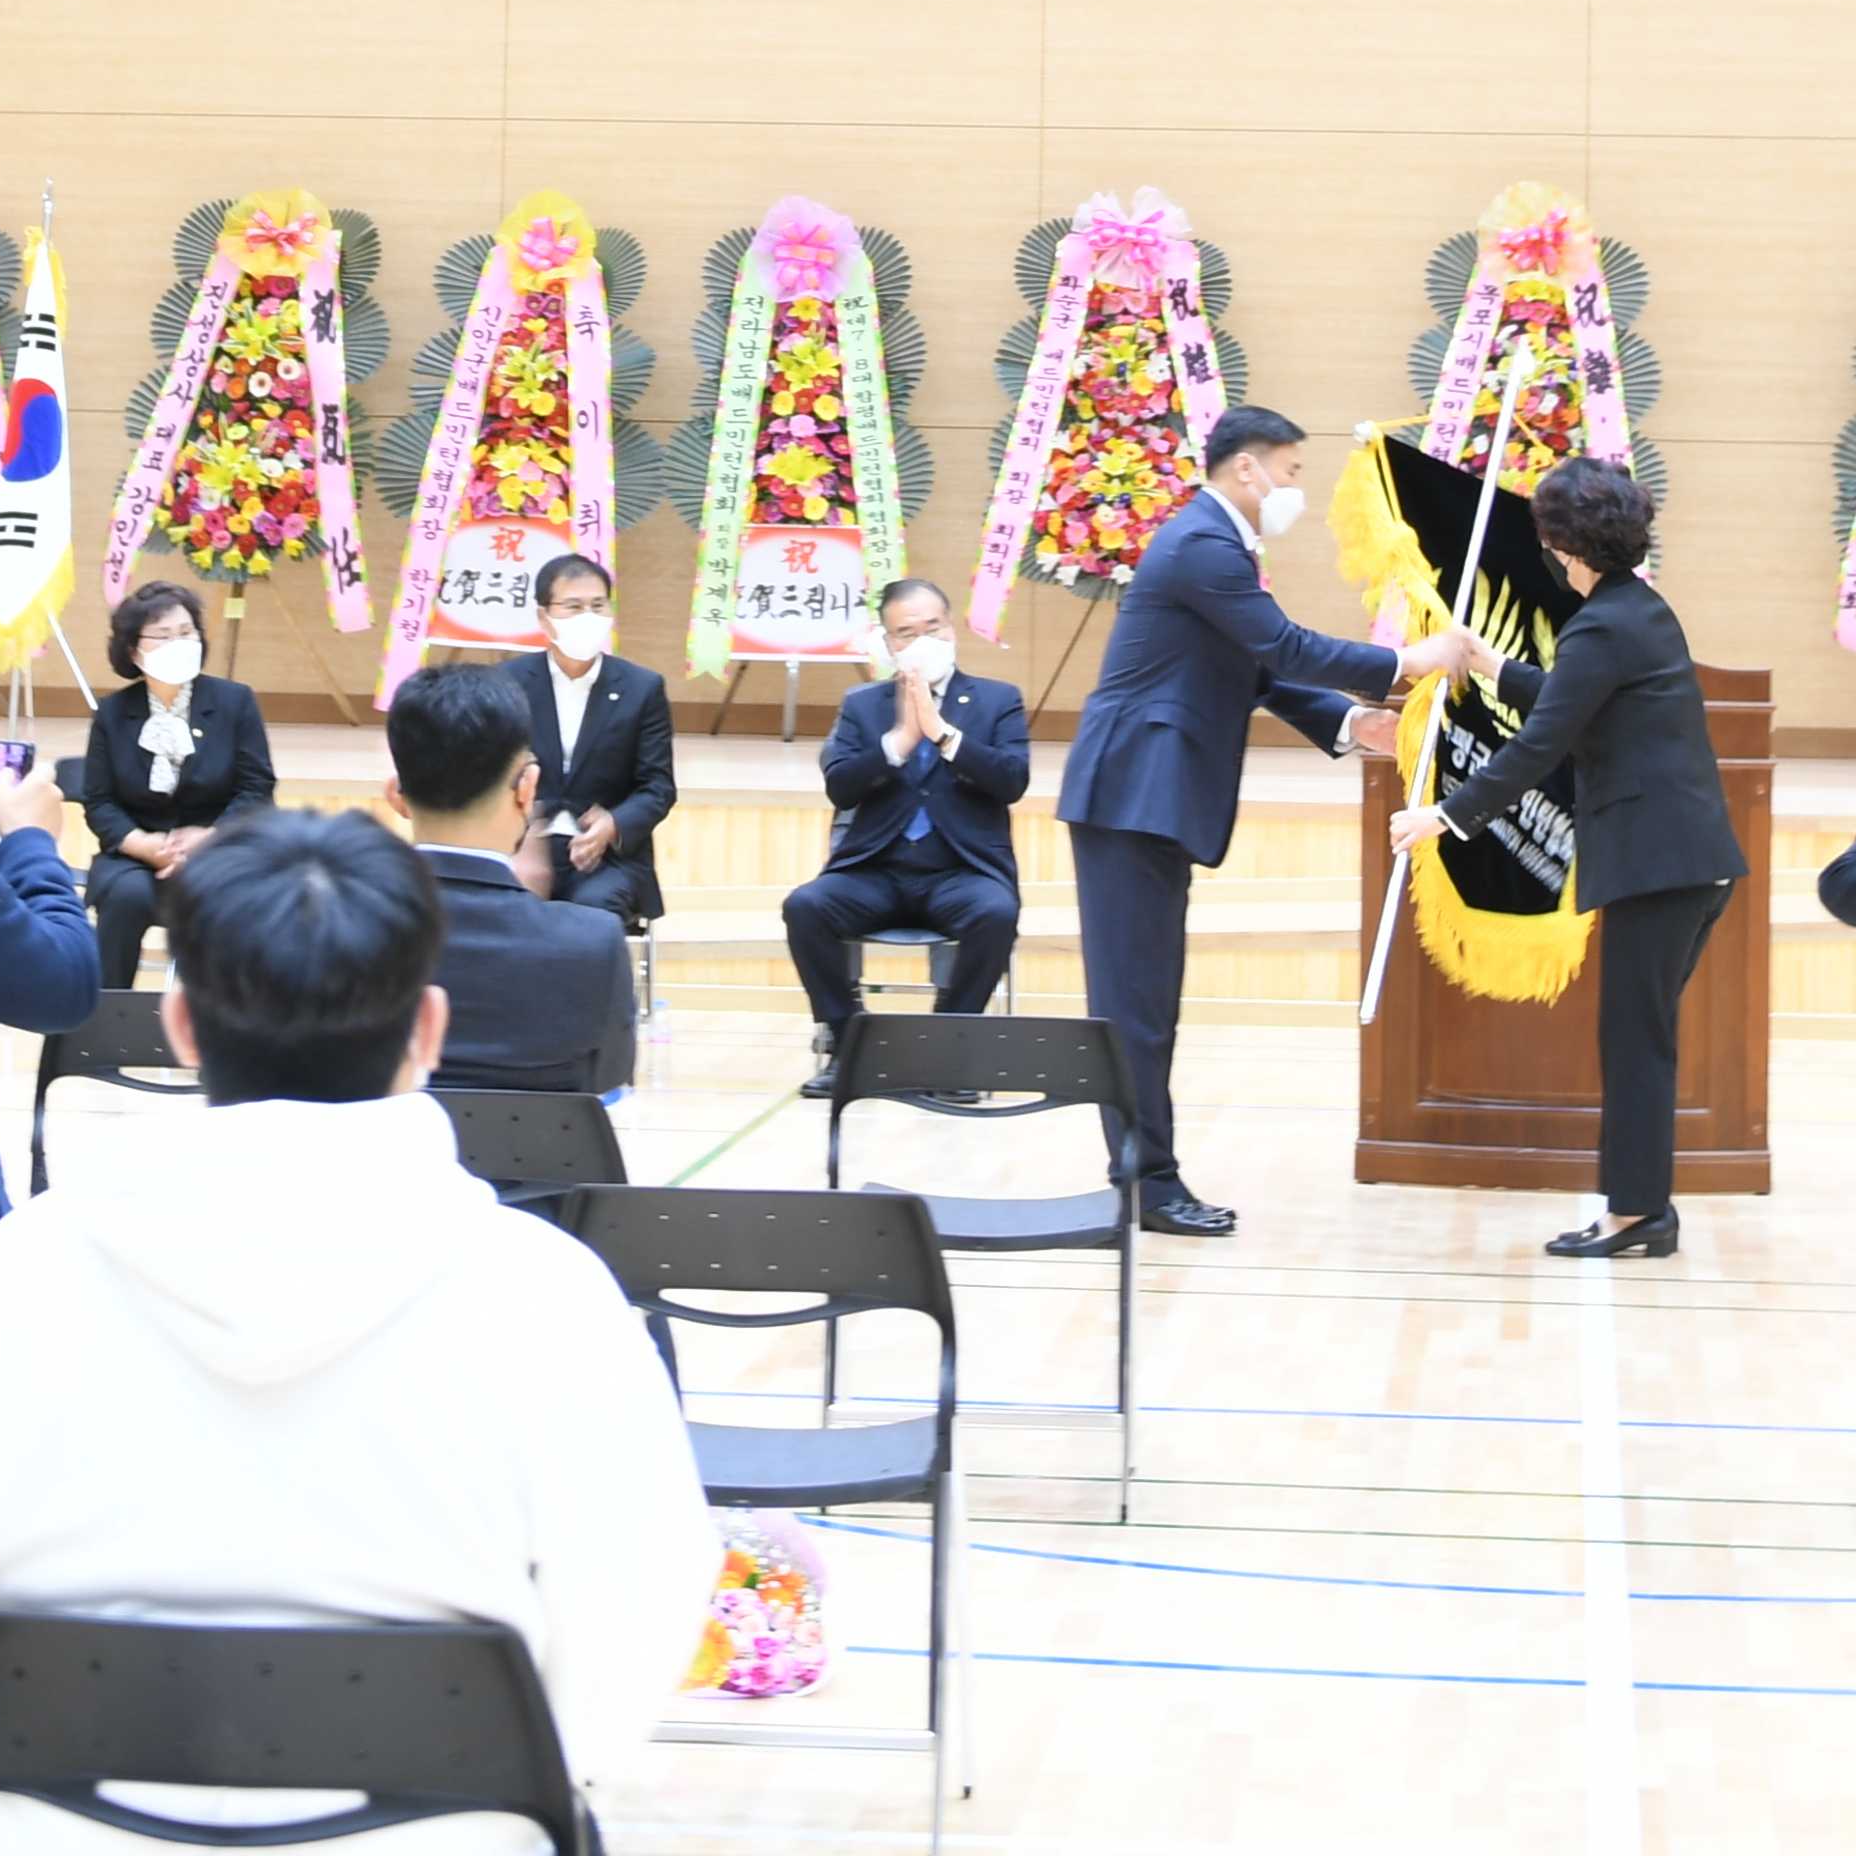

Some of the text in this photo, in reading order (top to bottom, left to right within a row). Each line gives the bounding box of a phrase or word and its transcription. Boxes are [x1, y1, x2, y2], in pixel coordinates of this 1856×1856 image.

[169, 281, 228, 408] 진성상사
[417, 304, 502, 541] 신안군배드민턴협회장
[714, 294, 766, 515] 전라남도배드민턴협회
[104, 485, 154, 584] 강인성
